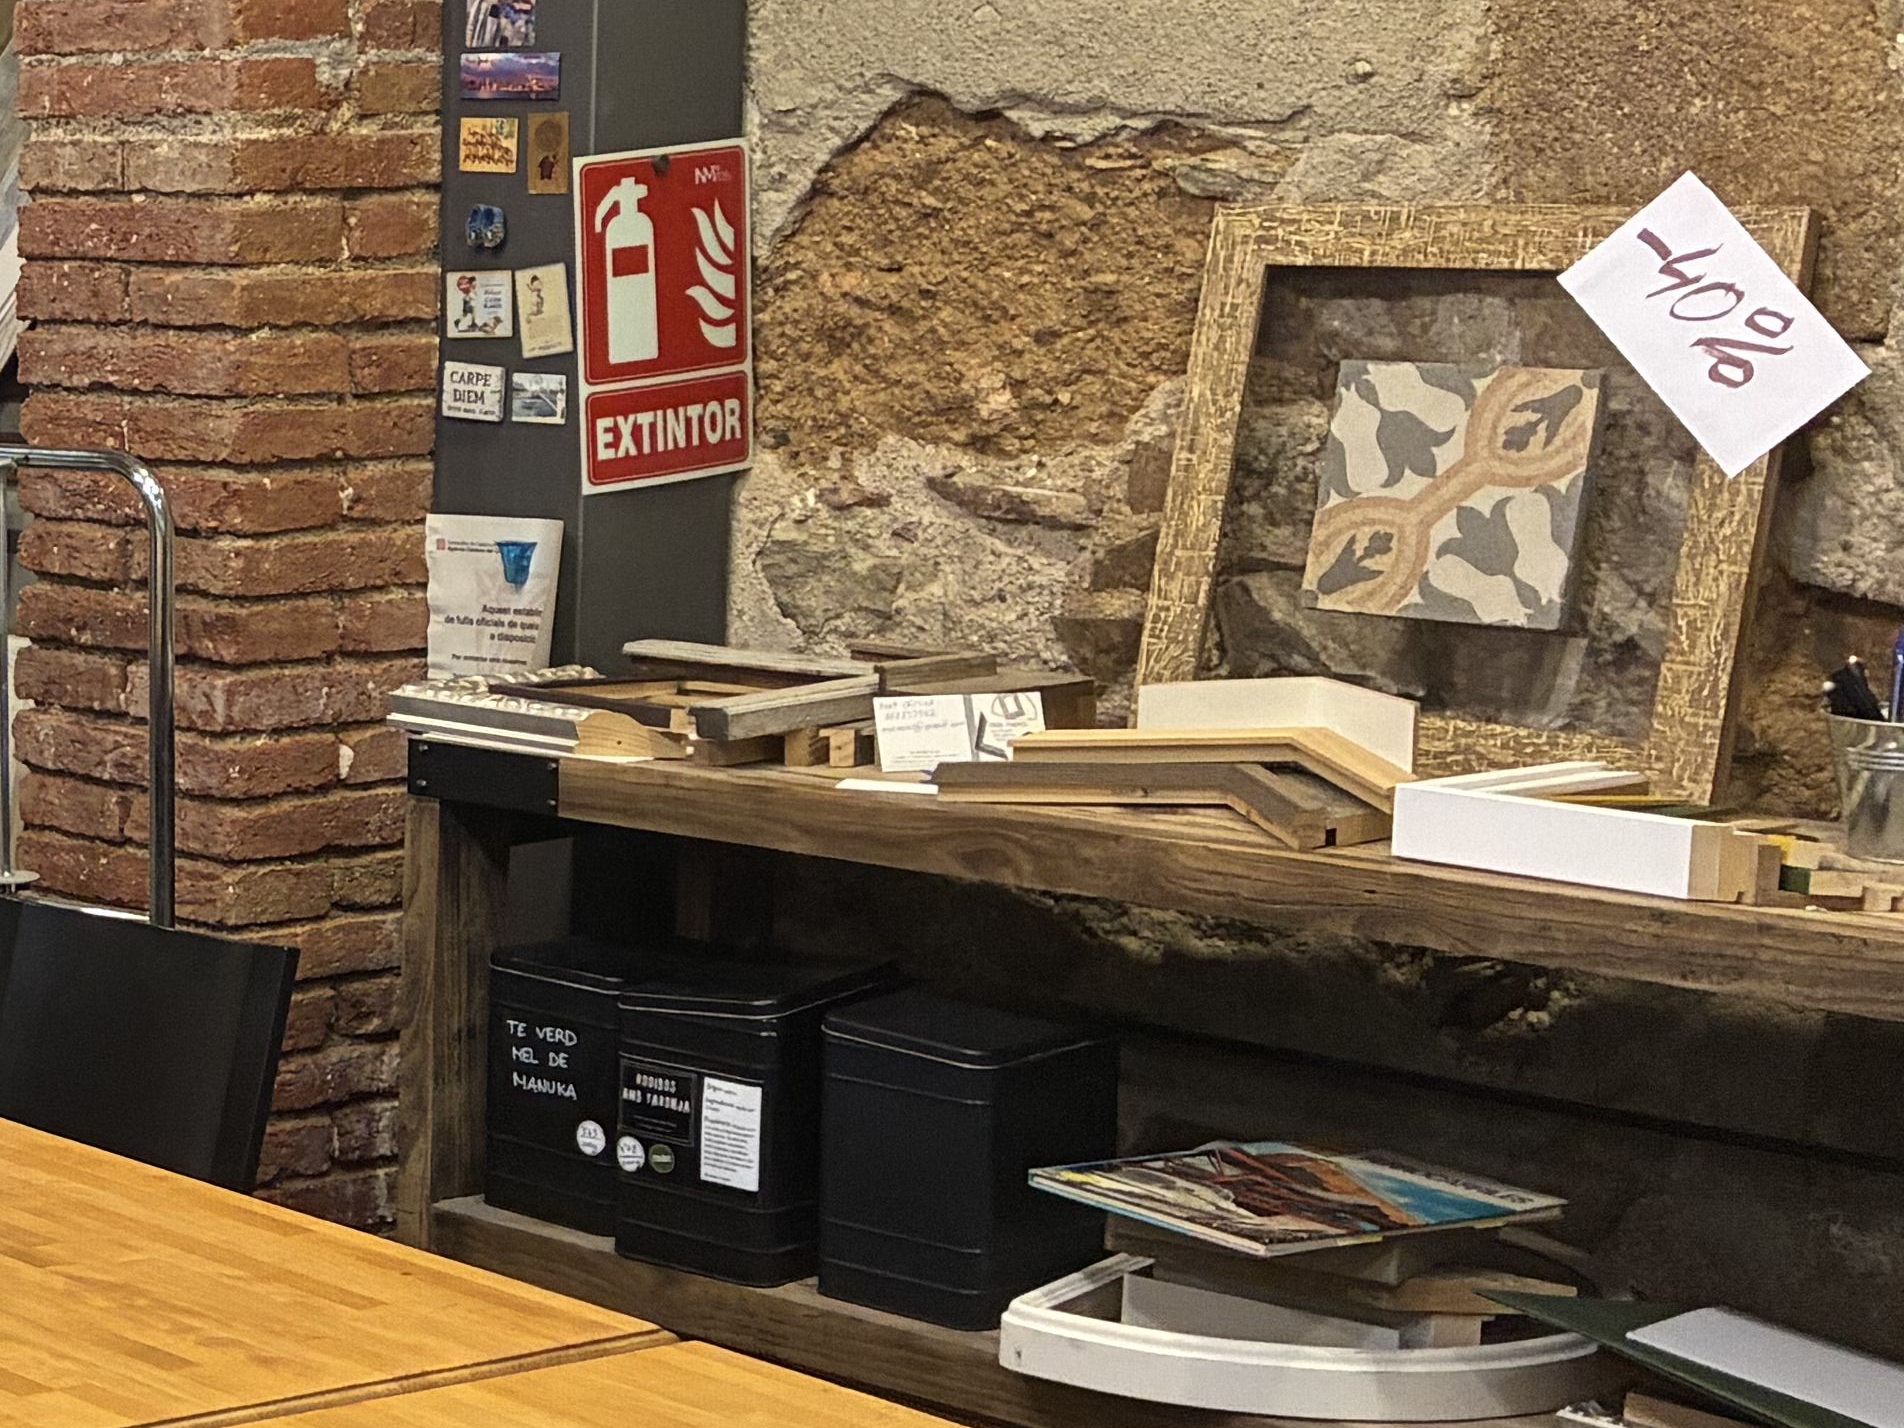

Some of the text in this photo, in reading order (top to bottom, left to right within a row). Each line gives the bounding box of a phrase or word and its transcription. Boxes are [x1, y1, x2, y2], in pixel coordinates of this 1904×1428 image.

[1637, 228, 1795, 390] -40%
[450, 371, 492, 387] CARPE
[453, 387, 485, 405] DIEM
[595, 398, 743, 461] EXTINTOR
[506, 1019, 577, 1046] TE VERD
[549, 1051, 569, 1068] DE
[512, 1071, 577, 1101] MANUKA
